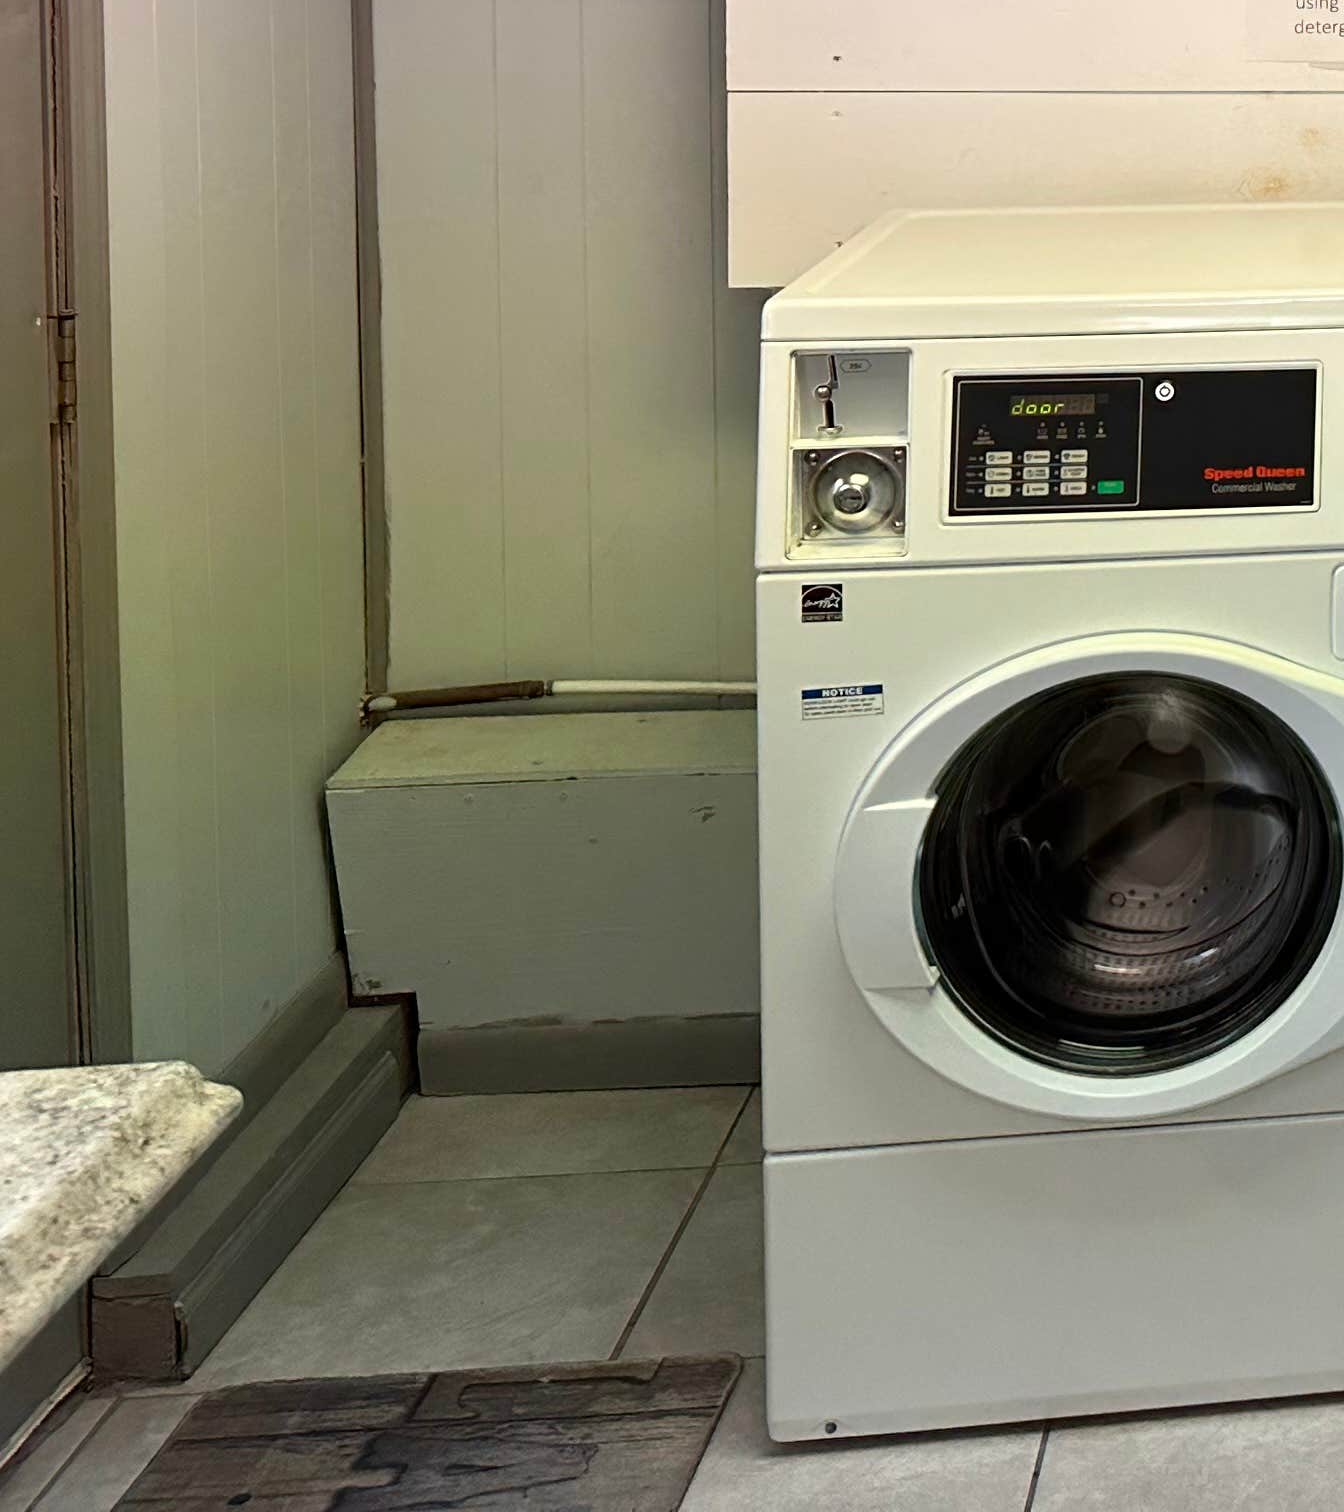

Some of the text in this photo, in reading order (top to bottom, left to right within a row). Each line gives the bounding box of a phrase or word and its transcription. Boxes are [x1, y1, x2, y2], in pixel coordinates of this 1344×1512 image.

[1011, 398, 1064, 415] door
[1203, 465, 1305, 481] Speed Queen
[1211, 481, 1263, 493] Commercial
[822, 687, 863, 698] NOTICE
